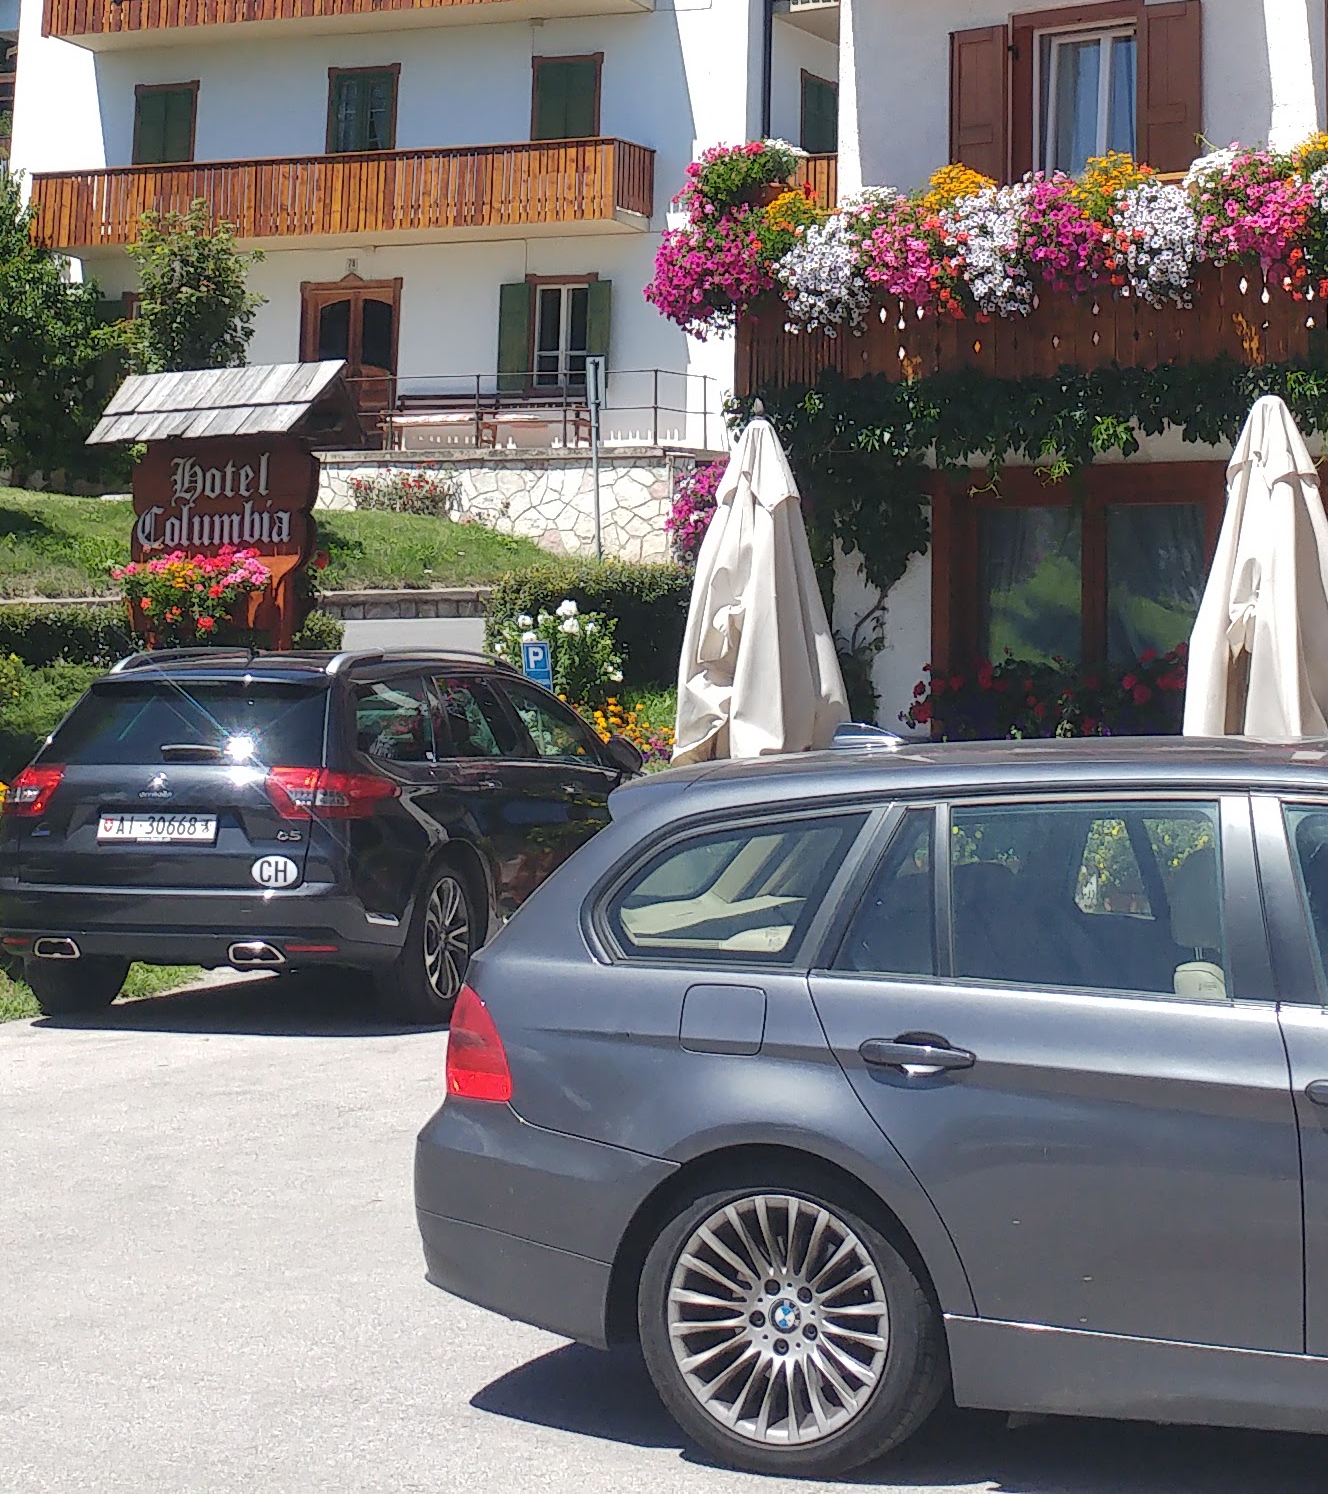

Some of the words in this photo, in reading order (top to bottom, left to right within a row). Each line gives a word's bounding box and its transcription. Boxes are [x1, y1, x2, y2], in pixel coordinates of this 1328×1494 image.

[171, 452, 270, 507] Hotel
[137, 500, 291, 547] Columbia
[528, 647, 543, 669] P
[145, 816, 198, 835] 30668
[259, 859, 287, 883] CH
